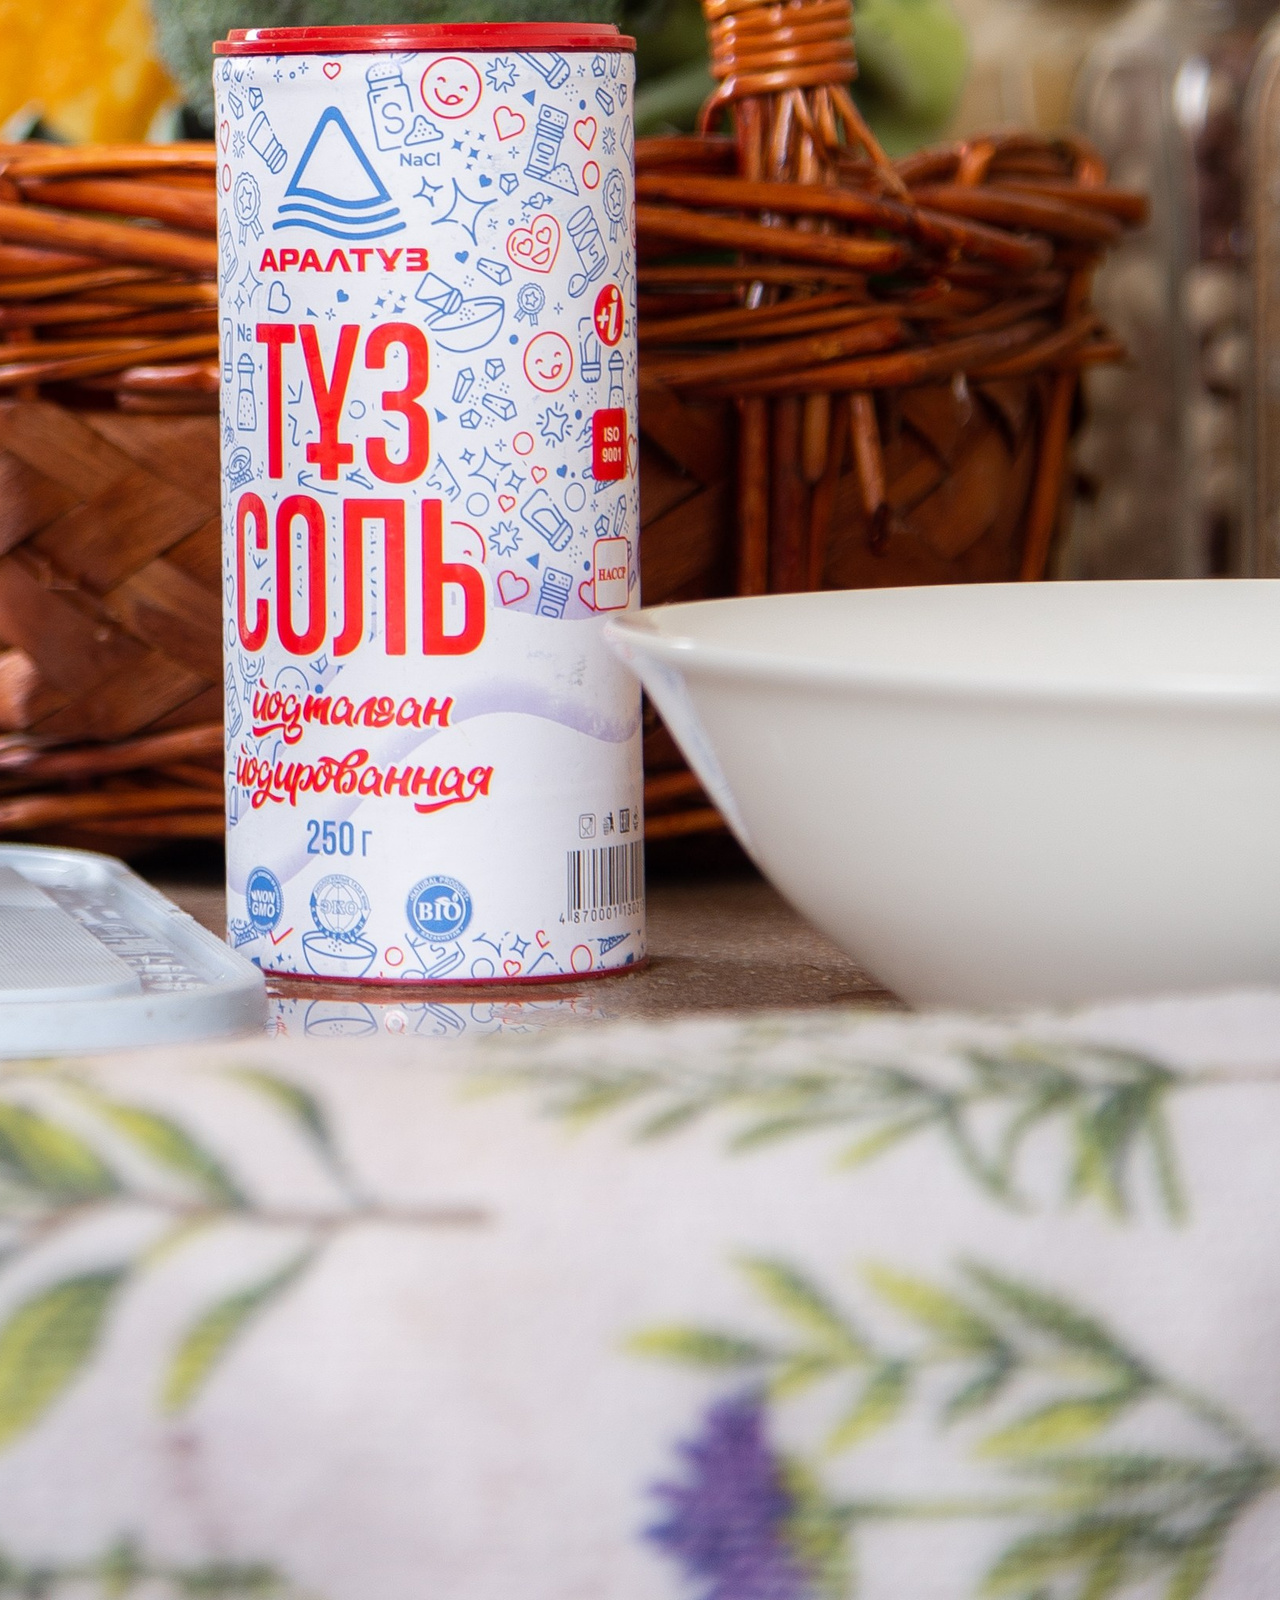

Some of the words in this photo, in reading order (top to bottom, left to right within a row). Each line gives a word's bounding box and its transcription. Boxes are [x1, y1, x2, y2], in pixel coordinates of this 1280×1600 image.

[399, 151, 441, 167] NaCl
[256, 322, 431, 484] ТҰЗ
[603, 426, 620, 443] ISO
[601, 447, 622, 463] 9001
[236, 492, 487, 657] СОЛЬ
[598, 566, 627, 581] HACCP
[236, 743, 494, 814] йодированная
[306, 819, 355, 856] 250
[361, 830, 373, 857] г
[256, 889, 276, 905] NON
[409, 877, 438, 901] NATURAL
[439, 876, 469, 899] PRODUCT
[252, 901, 276, 919] GMO
[320, 899, 359, 916] ЭКО
[418, 900, 462, 921] BIO
[573, 906, 618, 924] 870001
